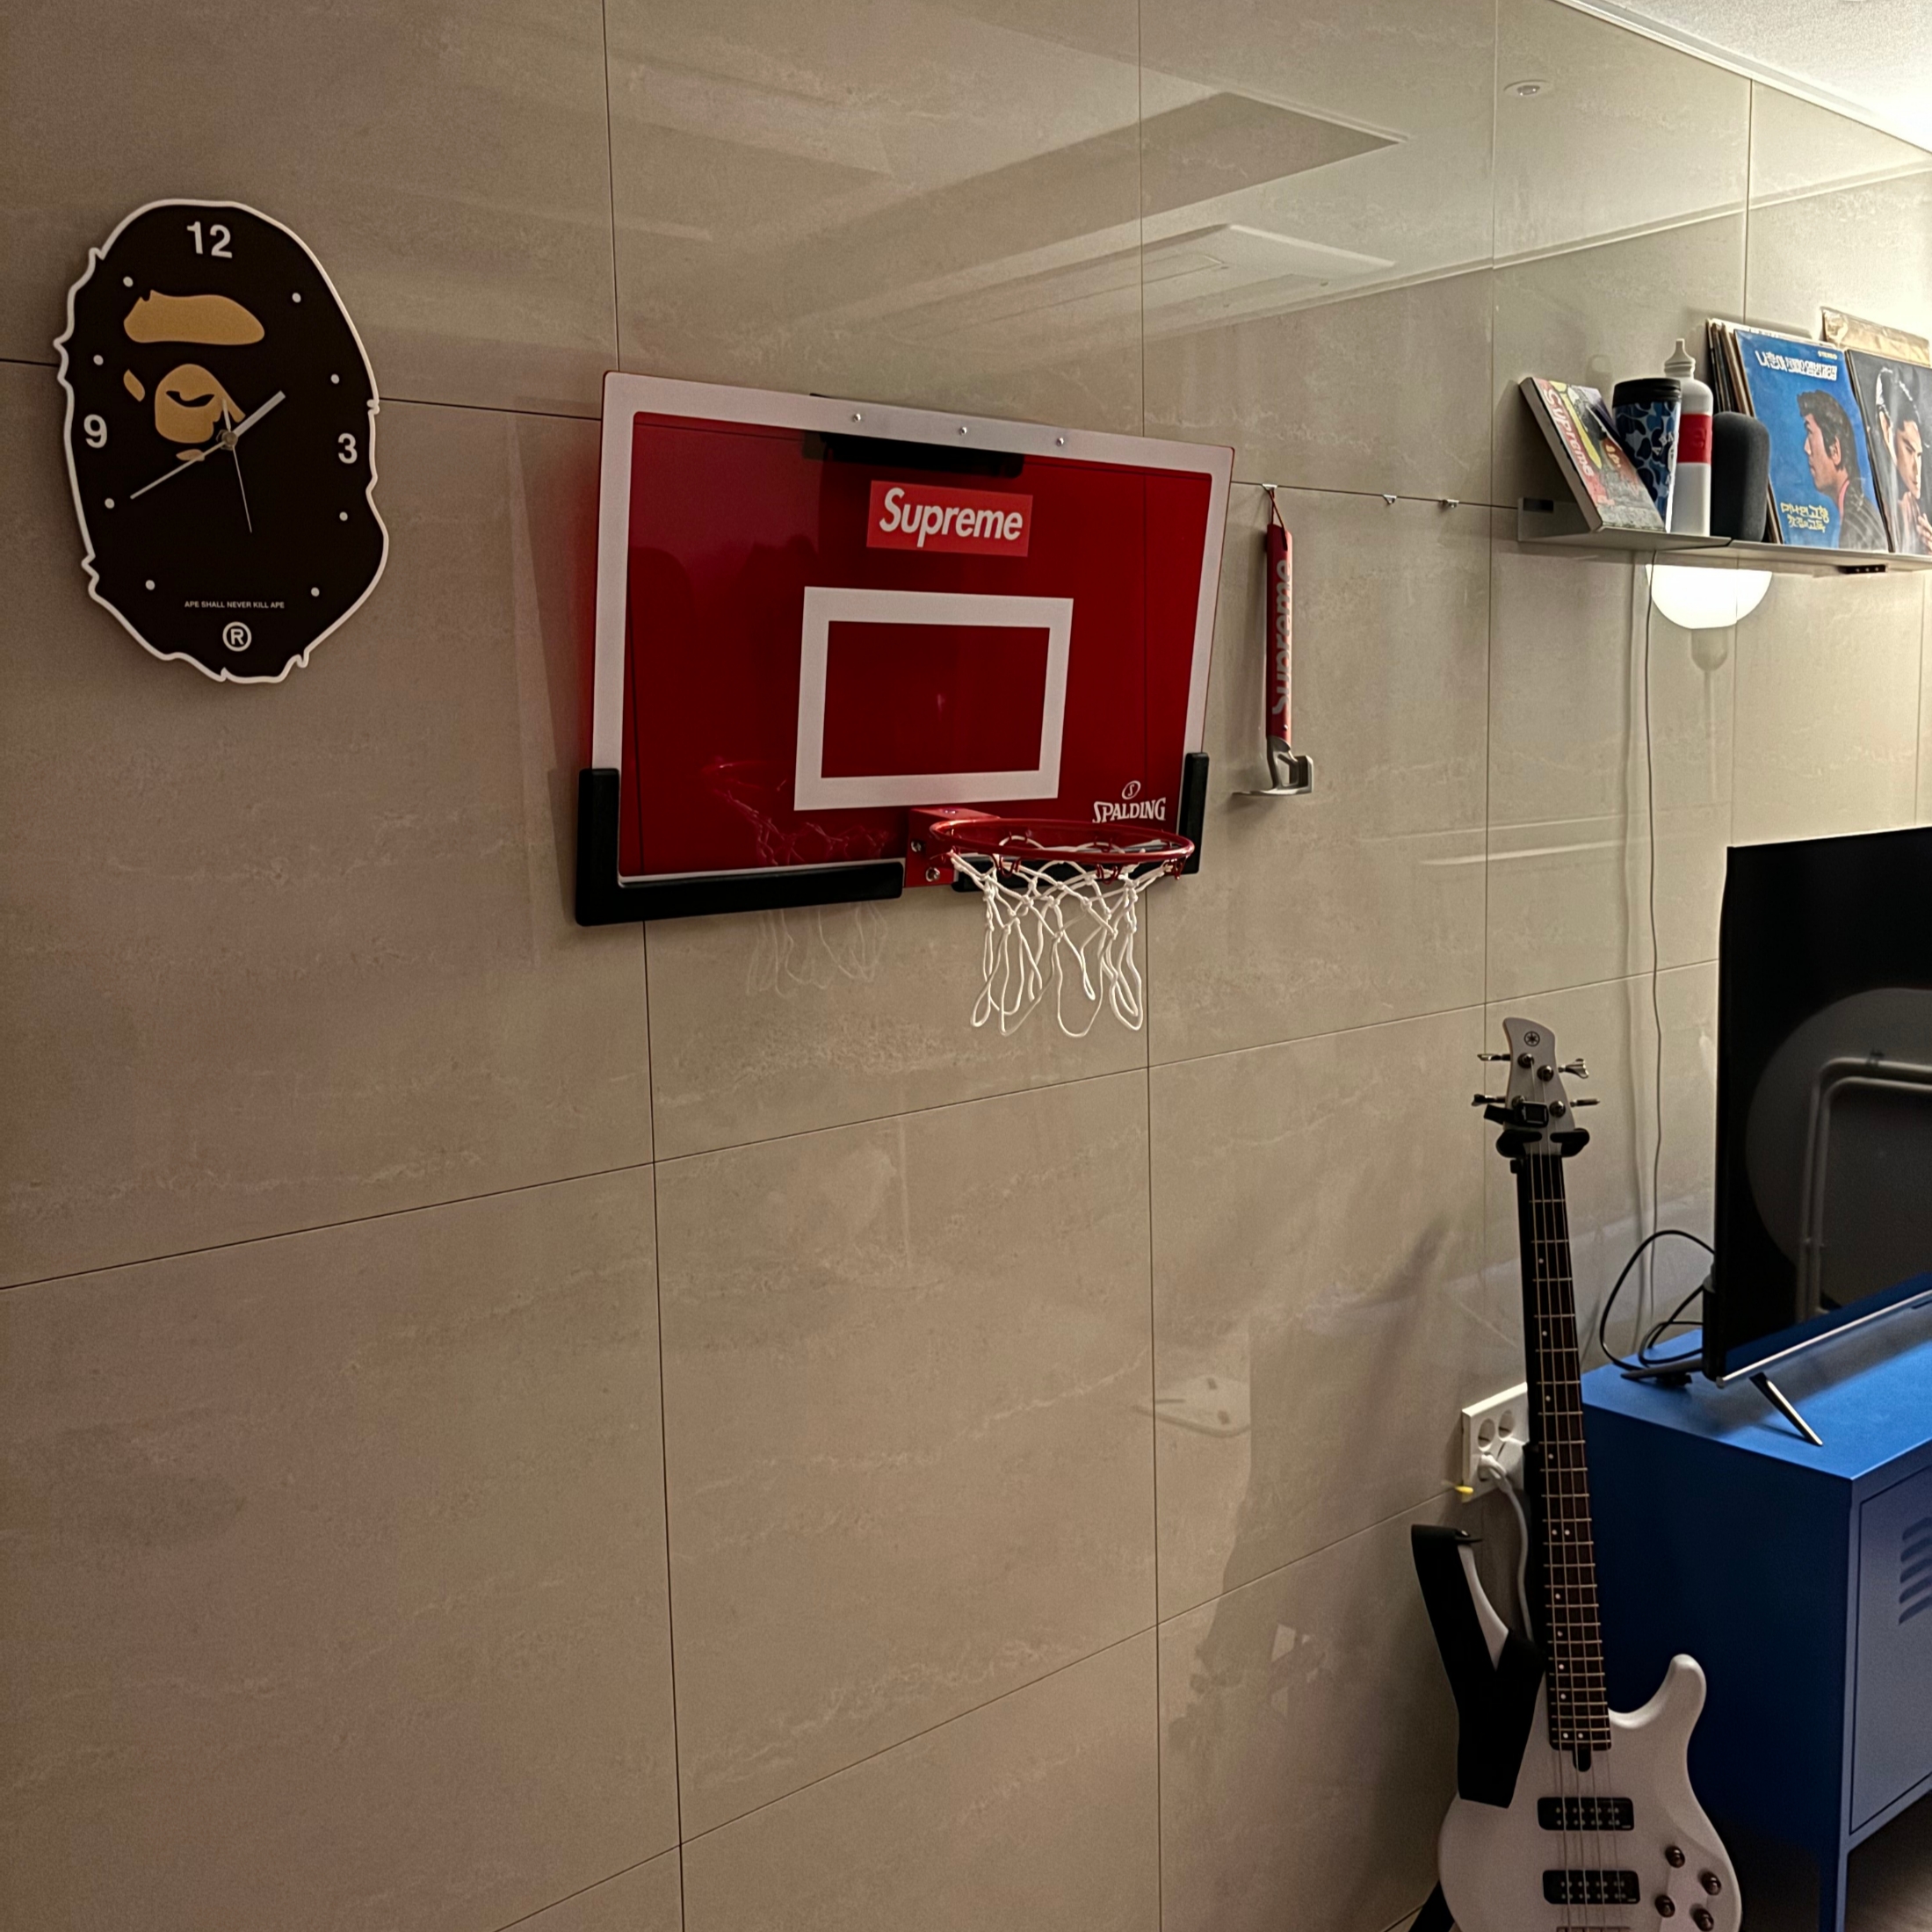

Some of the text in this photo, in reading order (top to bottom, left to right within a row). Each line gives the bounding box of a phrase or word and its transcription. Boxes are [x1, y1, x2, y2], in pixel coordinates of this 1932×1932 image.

[186, 221, 233, 258] 12
[83, 414, 107, 448] 9
[337, 432, 358, 464] 3
[879, 487, 1023, 548] Supreme
[1092, 796, 1167, 823] SPALDING
